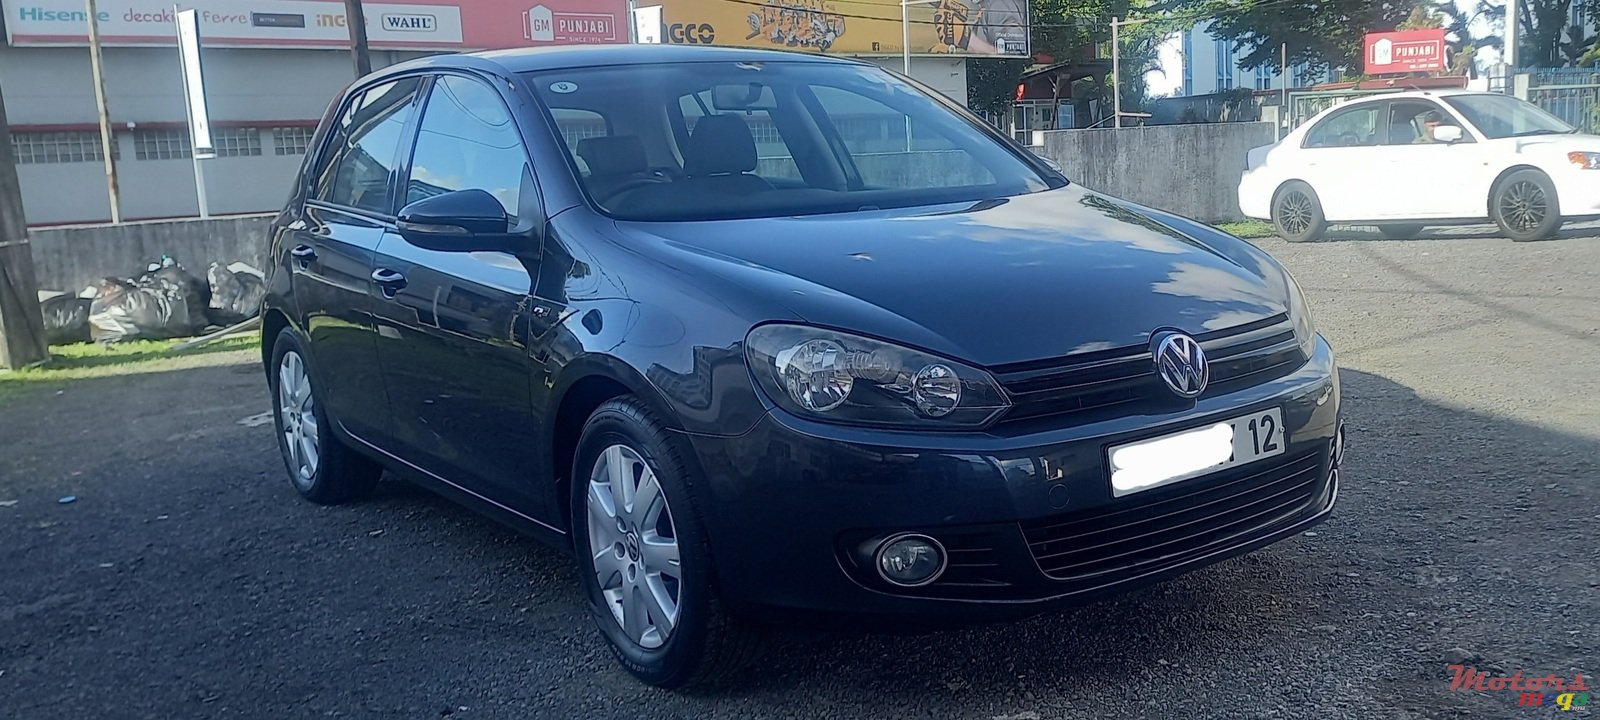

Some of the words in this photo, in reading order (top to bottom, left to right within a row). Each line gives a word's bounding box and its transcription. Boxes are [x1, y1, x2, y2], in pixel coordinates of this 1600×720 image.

[534, 18, 550, 31] GM
[559, 19, 609, 34] PUNJABI
[1395, 45, 1435, 57] PUNJABI
[1248, 414, 1278, 456] 12
